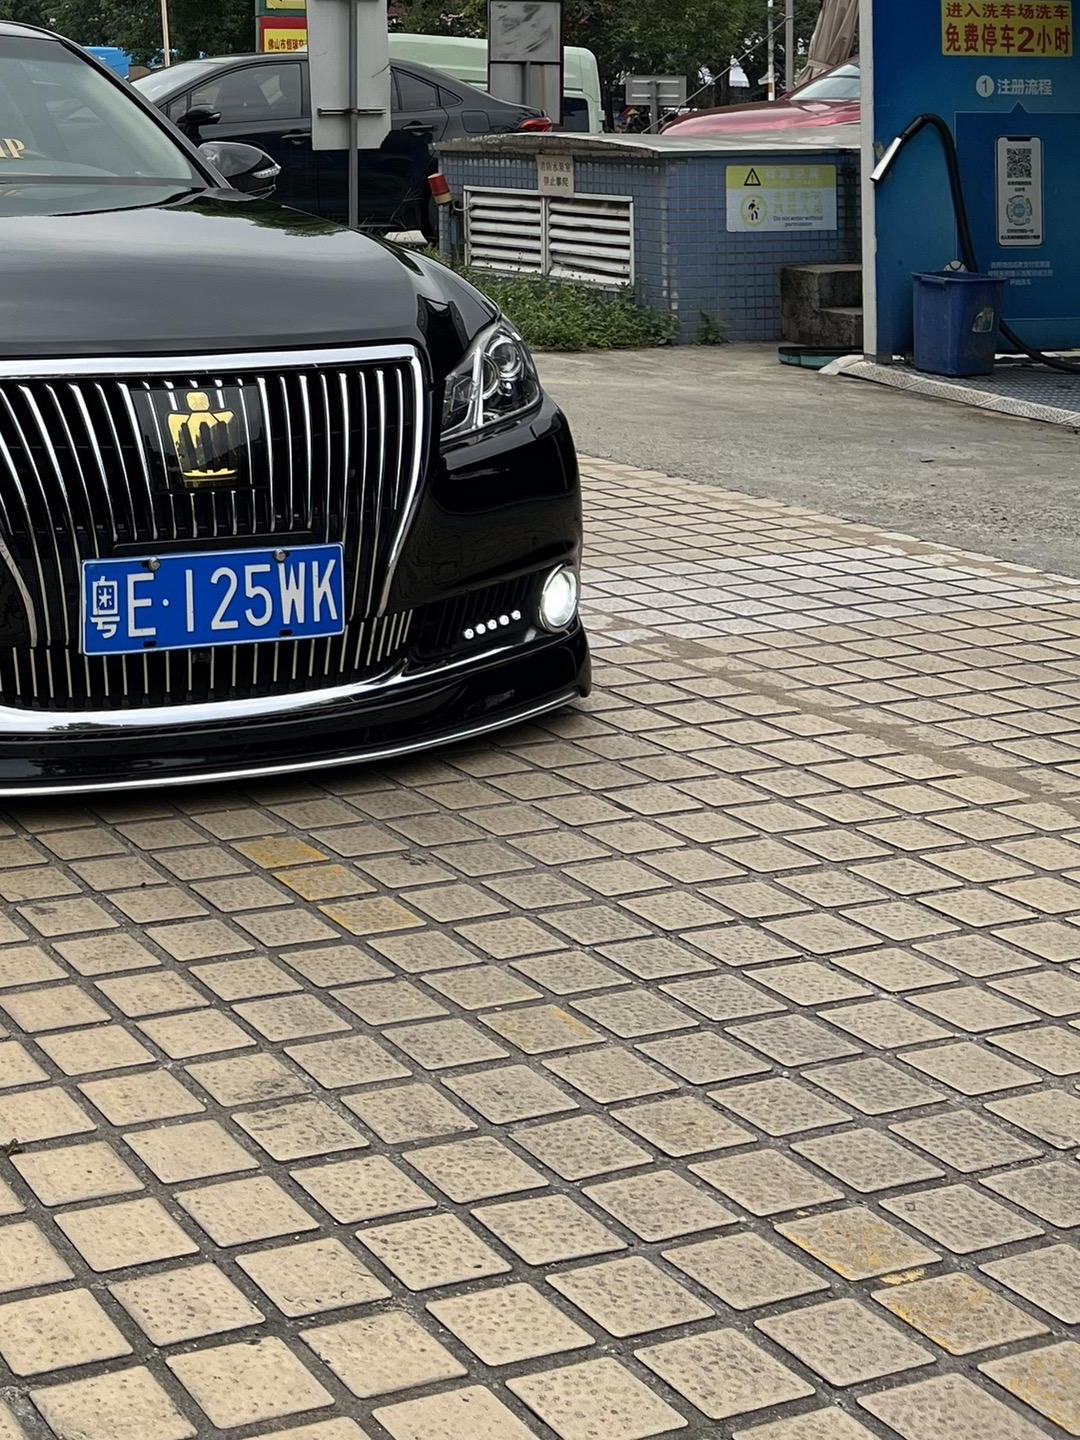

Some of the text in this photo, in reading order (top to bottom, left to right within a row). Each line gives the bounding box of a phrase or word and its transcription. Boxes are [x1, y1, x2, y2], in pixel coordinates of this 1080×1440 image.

[946, 3, 1069, 19] 进入洗车场洗车
[945, 23, 1070, 54] 免费停车2小时
[997, 79, 1052, 95] 注册流程
